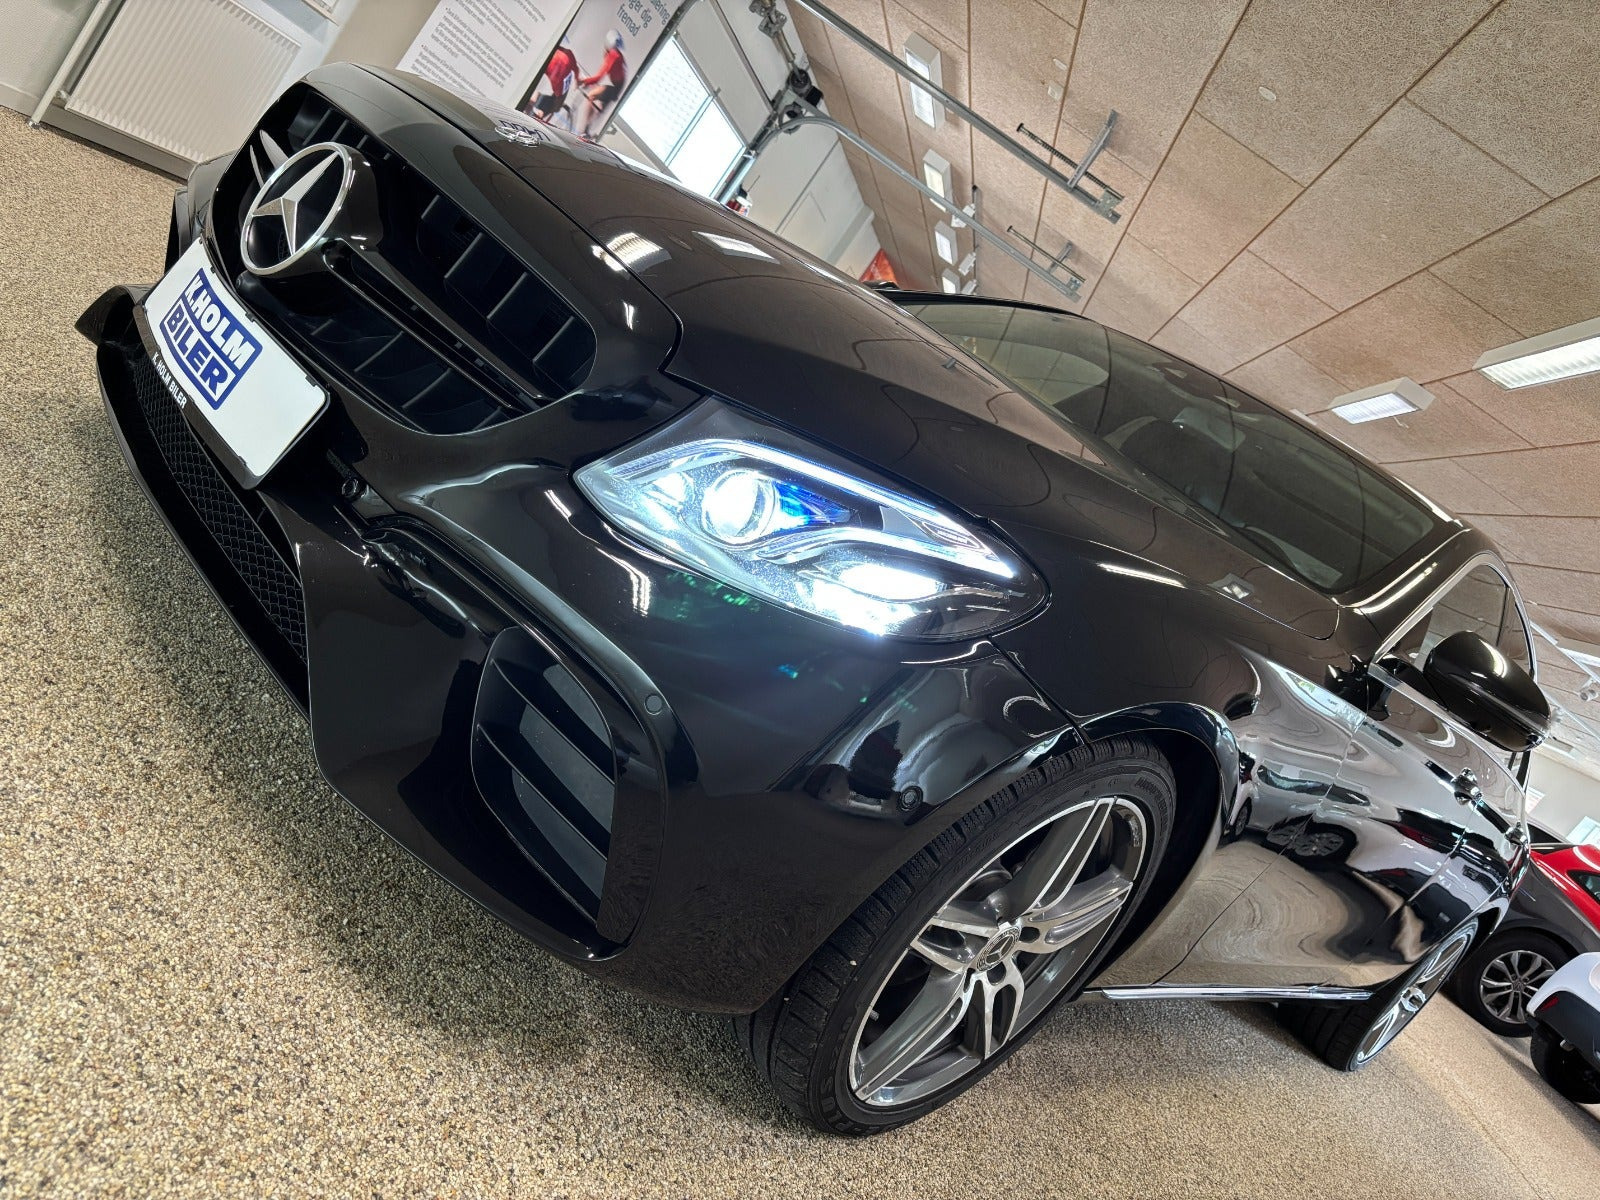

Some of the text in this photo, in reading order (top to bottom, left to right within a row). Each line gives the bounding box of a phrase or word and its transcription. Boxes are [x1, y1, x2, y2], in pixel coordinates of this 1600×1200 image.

[616, 4, 641, 37] fremad
[167, 303, 228, 395] BILER
[157, 362, 172, 389] HOLM
[168, 380, 188, 409] BILER
